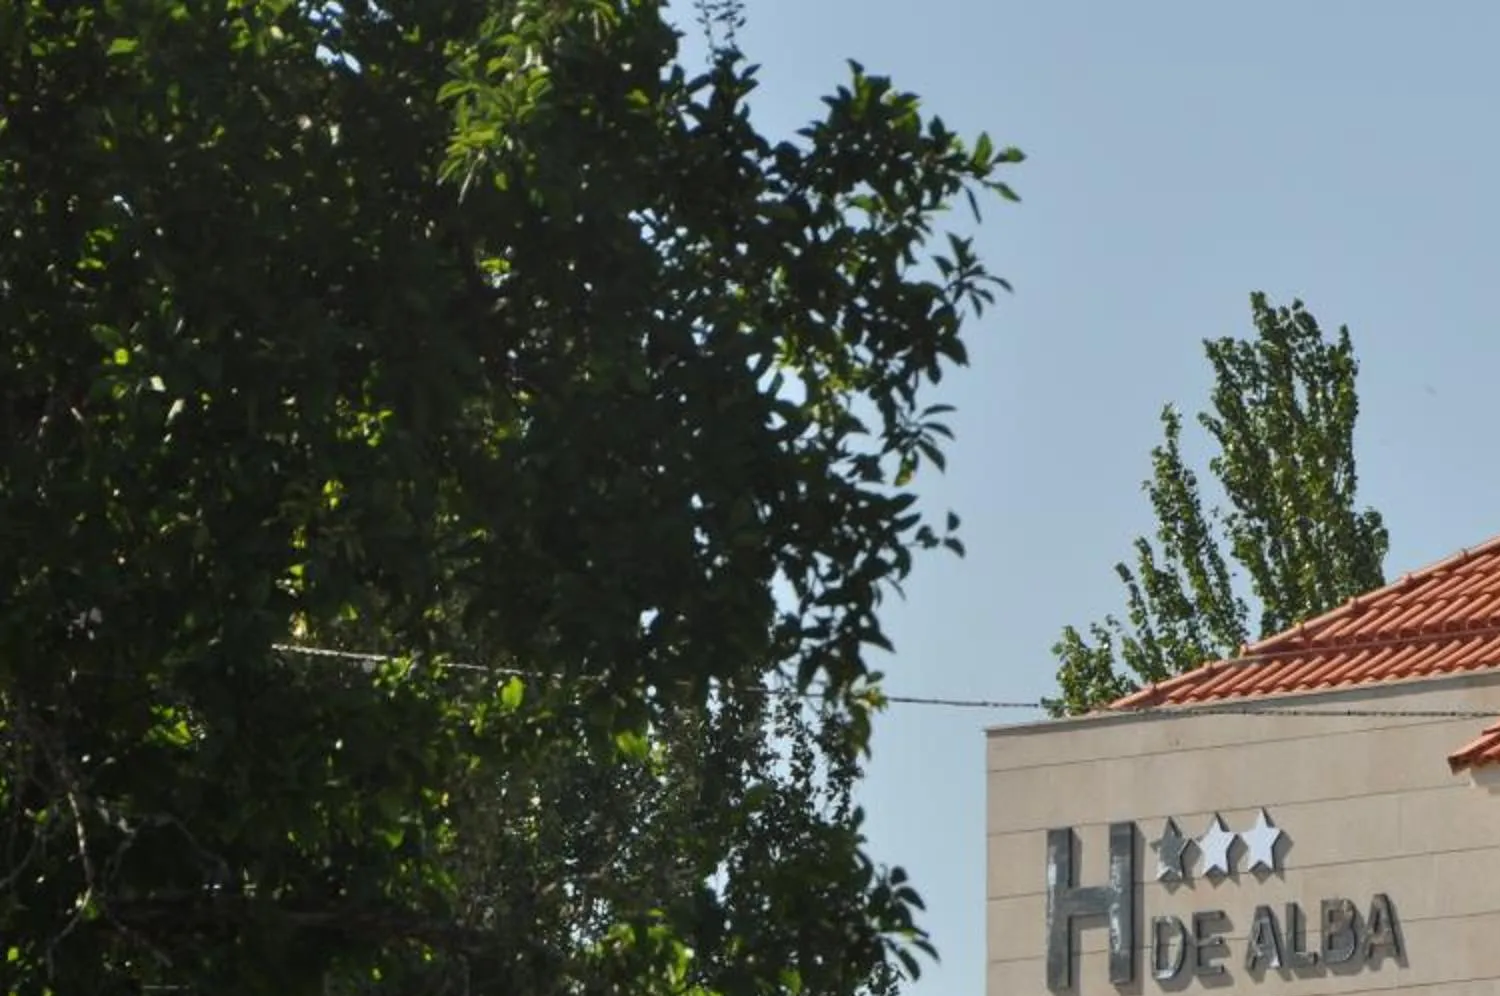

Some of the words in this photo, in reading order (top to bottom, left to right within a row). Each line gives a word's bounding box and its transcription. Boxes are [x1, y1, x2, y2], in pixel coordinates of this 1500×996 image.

[1046, 820, 1137, 991] H
[1151, 909, 1226, 982] DE
[1247, 892, 1402, 972] ALBA
